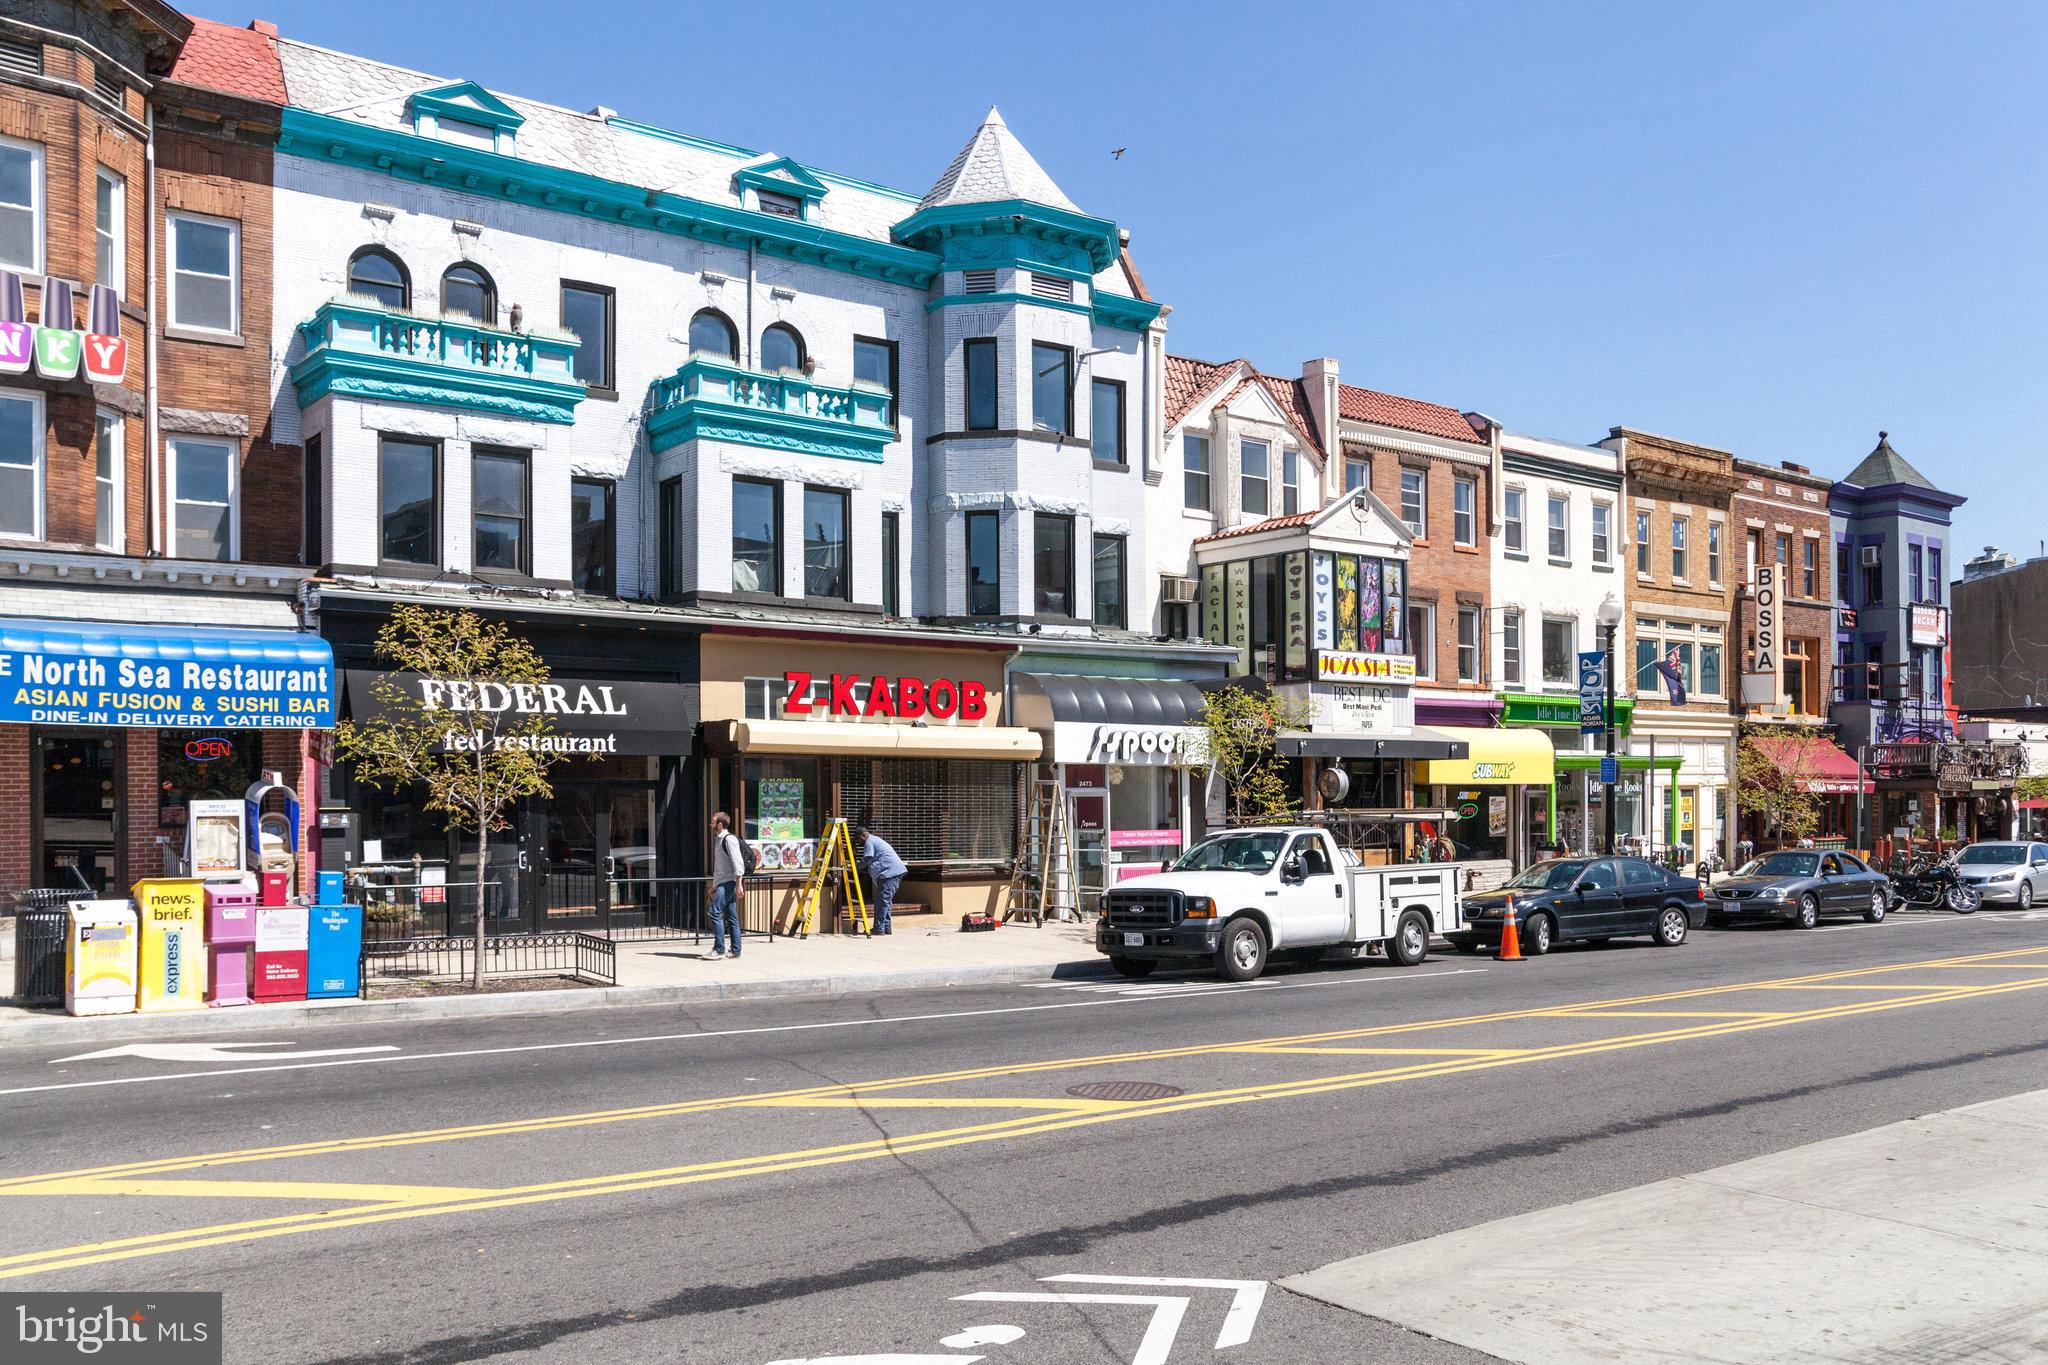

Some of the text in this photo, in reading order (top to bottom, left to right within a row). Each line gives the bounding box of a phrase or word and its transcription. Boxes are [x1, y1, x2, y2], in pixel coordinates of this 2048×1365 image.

[1234, 568, 1245, 642] WAXXING
[1758, 569, 1773, 669] BOSSA
[23, 655, 106, 687] North
[118, 658, 171, 689] Sea
[183, 662, 328, 693] Restaurant
[1364, 657, 1391, 678] SPA
[784, 671, 987, 720] Z-KABOB
[1333, 685, 1392, 703] BEST DC
[1581, 659, 1603, 714] SHOP
[14, 688, 330, 713] ASIAN FUSION & SUSHI BAR
[418, 679, 627, 715] FEDERAL
[31, 709, 316, 726] DINE-IN DELIVERY CATERING
[1537, 706, 1551, 720] Idle
[1553, 706, 1571, 720] Time
[185, 742, 231, 757] OPEN
[494, 733, 617, 752] restaurant
[1472, 762, 1515, 779] SUBWAY
[1589, 780, 1603, 795] Idle
[1624, 780, 1642, 794] Books
[1461, 807, 1475, 815] OPEN
[151, 894, 195, 905] news.
[154, 907, 192, 920] brief.
[322, 917, 348, 925] Washington
[168, 934, 180, 993] express
